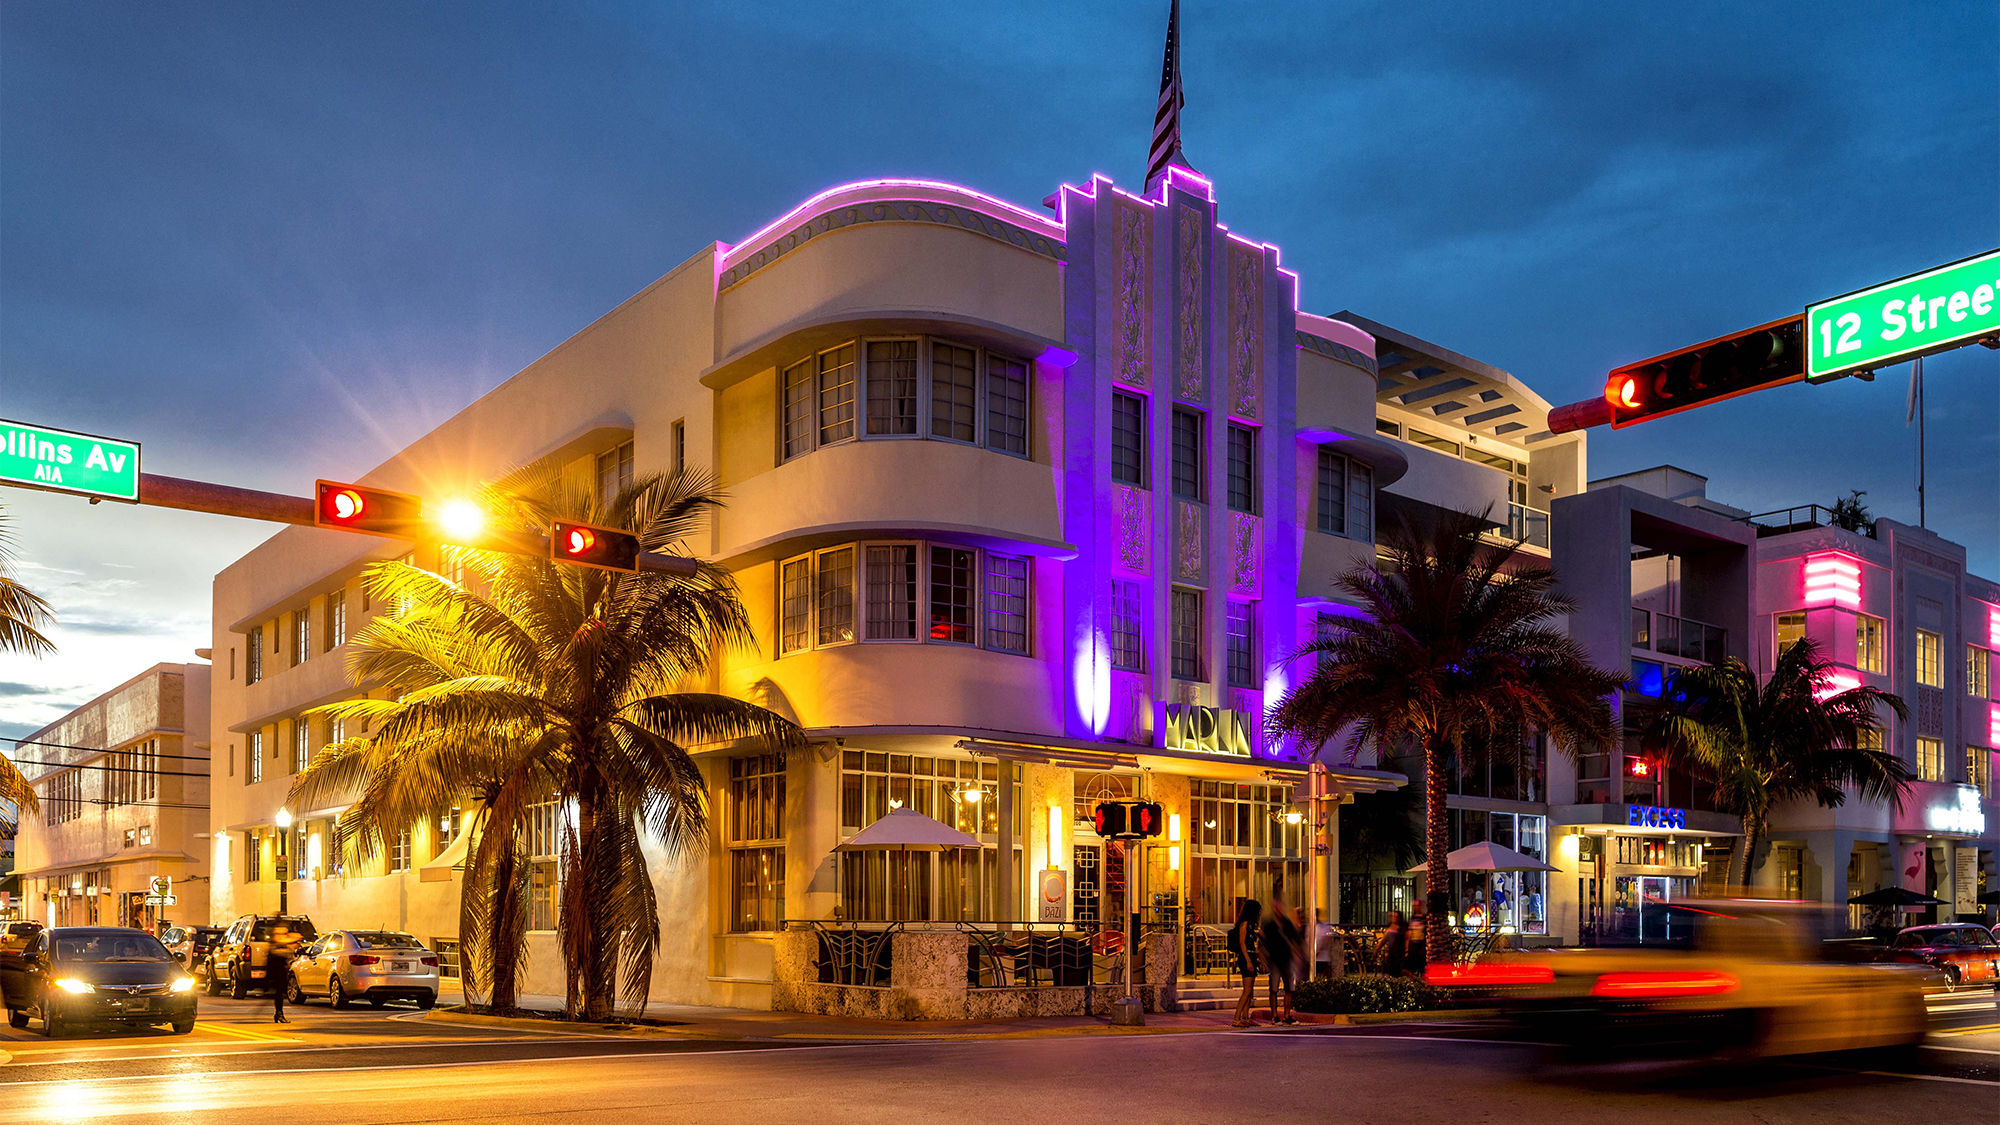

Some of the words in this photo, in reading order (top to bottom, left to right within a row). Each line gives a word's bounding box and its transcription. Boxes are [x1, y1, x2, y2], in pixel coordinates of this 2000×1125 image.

[1820, 312, 1861, 358] 12
[1880, 279, 2000, 341] Stree
[85, 444, 126, 473] Av
[1164, 702, 1252, 758] MARLIN
[1628, 804, 1686, 829] EXCESS
